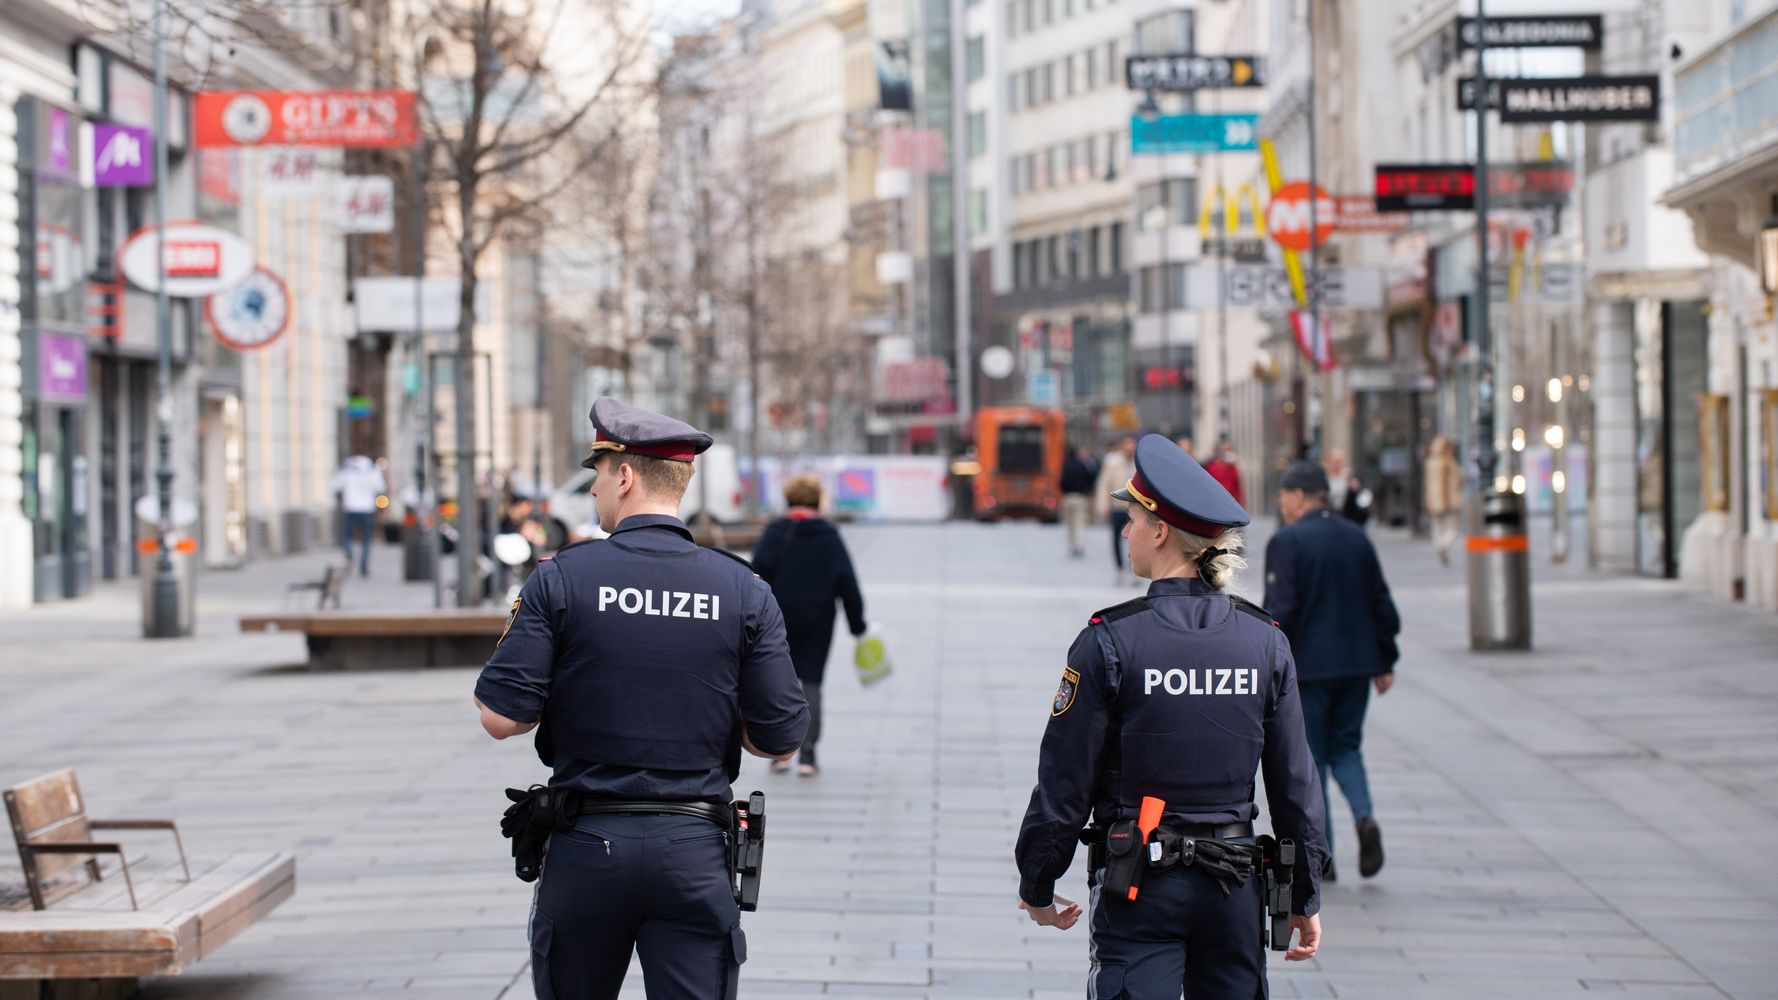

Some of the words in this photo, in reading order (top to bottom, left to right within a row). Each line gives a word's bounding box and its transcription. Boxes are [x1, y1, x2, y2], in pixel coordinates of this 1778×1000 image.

[281, 94, 398, 130] GIFTS
[1506, 85, 1652, 112] HALLHUBER
[598, 586, 720, 621] POLIZEI
[1144, 668, 1259, 696] POLIZEI
